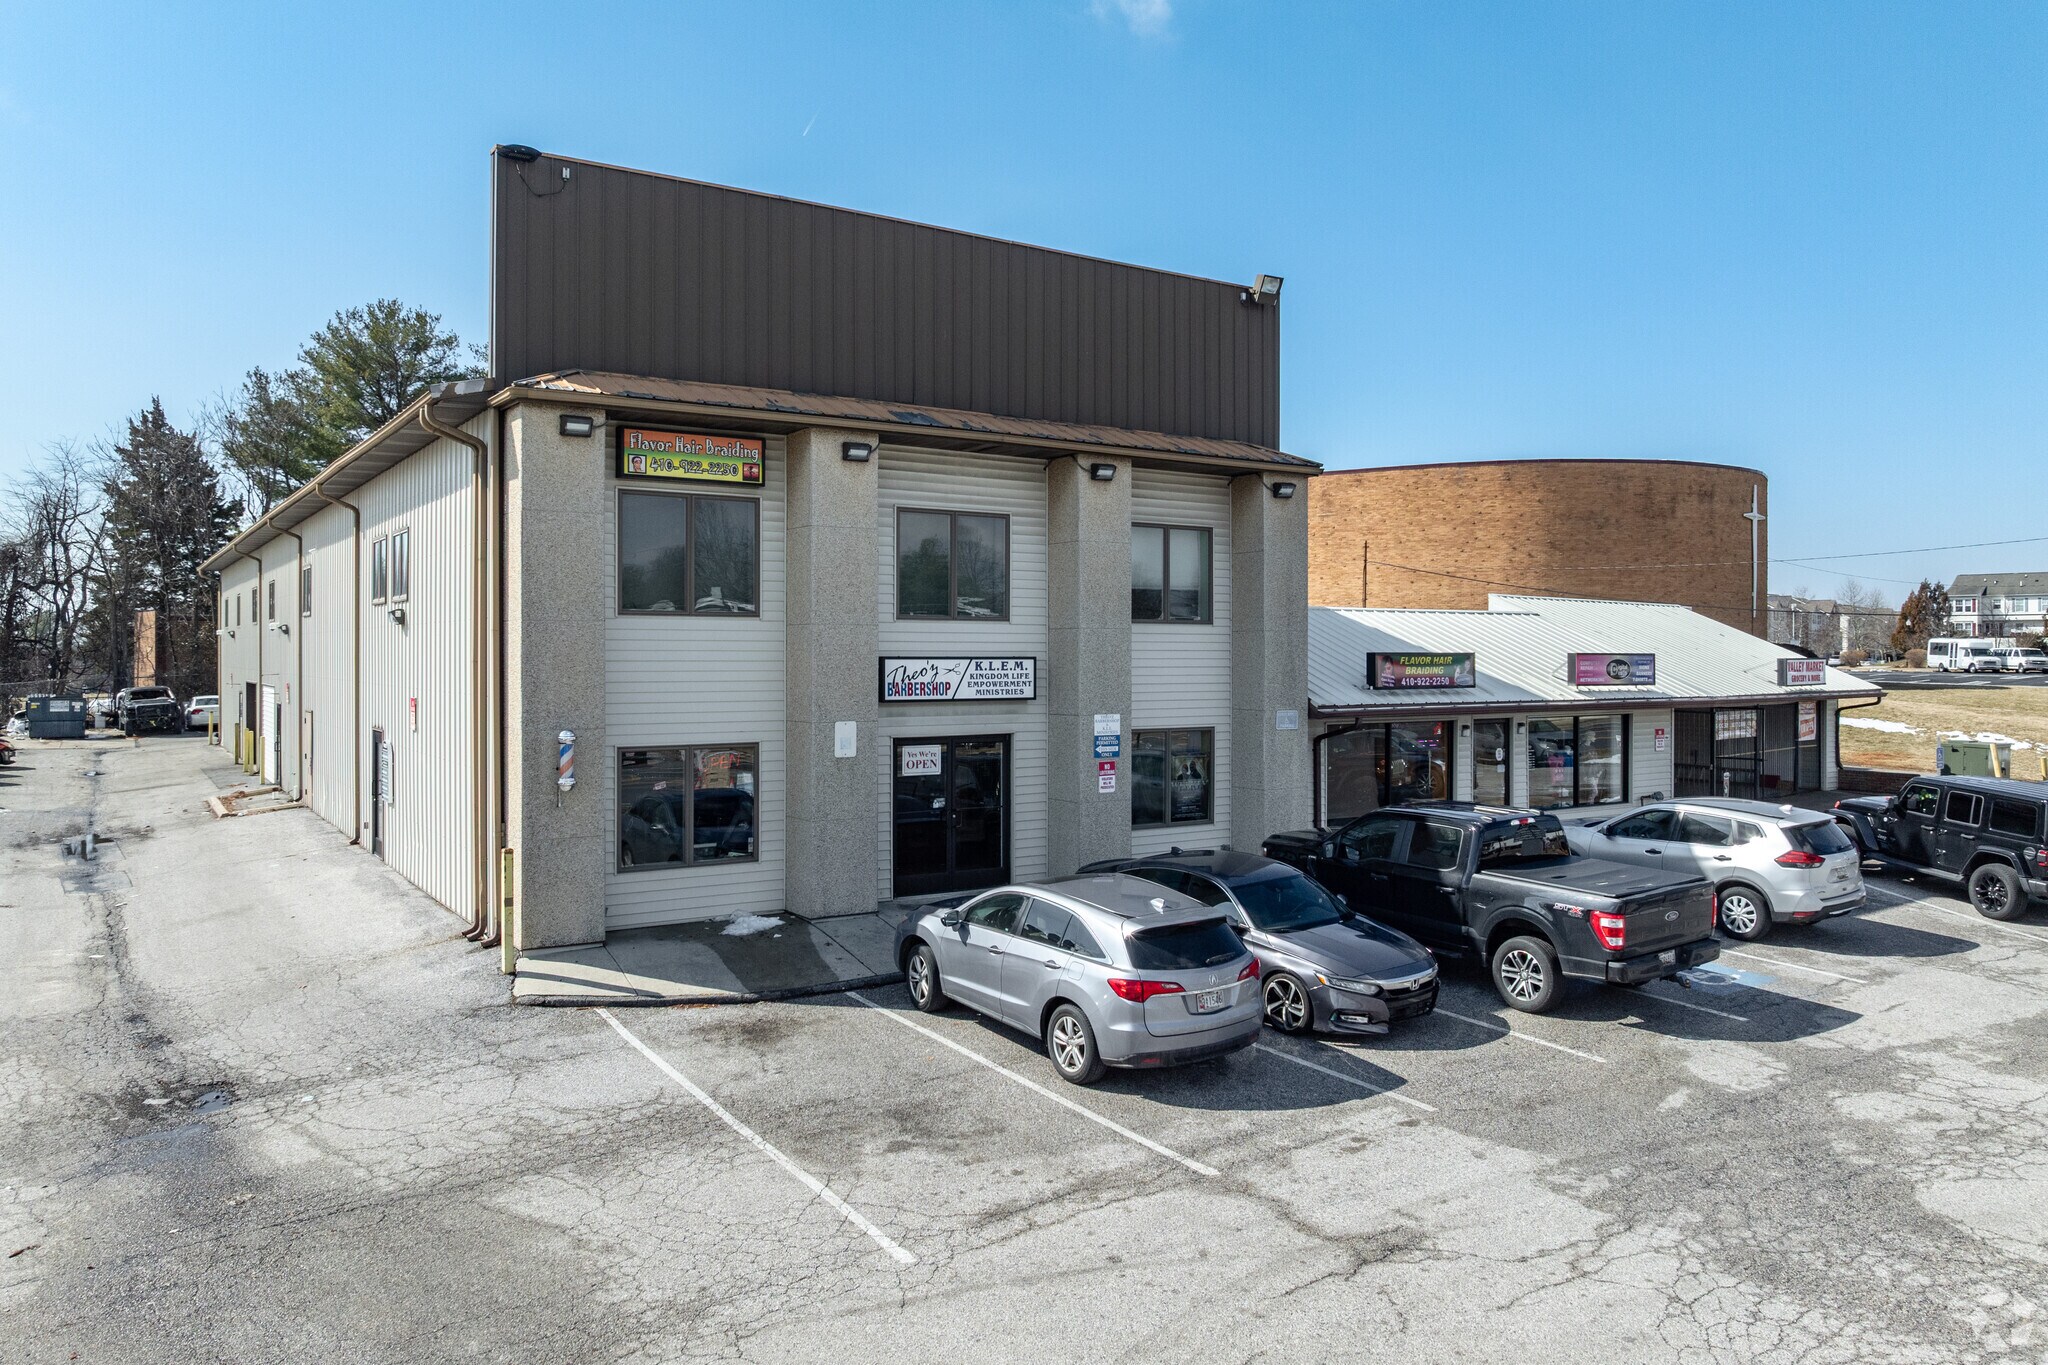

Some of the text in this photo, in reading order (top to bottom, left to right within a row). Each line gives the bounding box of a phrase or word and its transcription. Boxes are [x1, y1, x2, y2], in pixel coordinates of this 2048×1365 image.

[629, 431, 759, 462] Flavor Hair Braiding
[650, 456, 739, 476] 410-922-2250
[1400, 656, 1453, 665] FLAVOR HAIR
[974, 661, 1028, 671] K.L.E.M.
[1787, 661, 1824, 672] VALLEY MARKET
[1011, 672, 1030, 680] LIFE
[967, 680, 1032, 688] EMPOWERMENT
[1401, 677, 1449, 686] 410-922-2250
[887, 681, 951, 697] BARBERSHOP
[906, 759, 937, 769] OPEN
